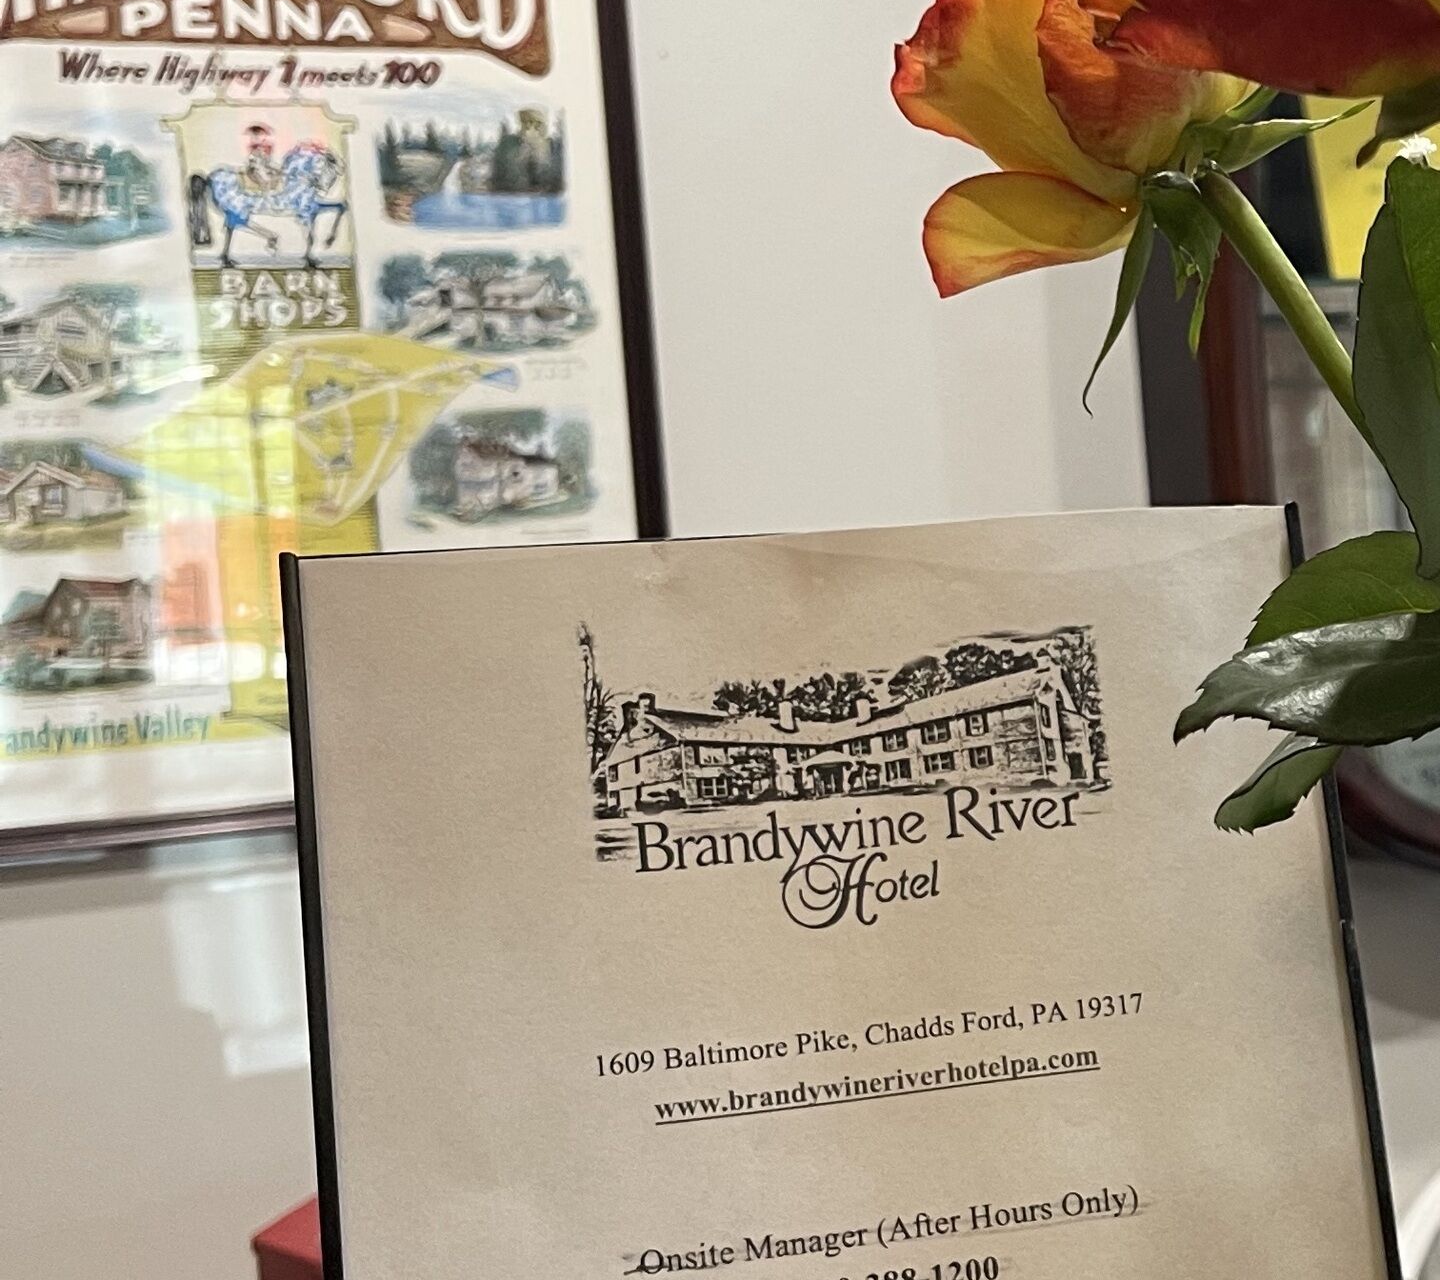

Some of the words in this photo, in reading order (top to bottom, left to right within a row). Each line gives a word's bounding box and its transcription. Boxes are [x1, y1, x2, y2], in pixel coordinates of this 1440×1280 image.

[59, 51, 147, 83] Where
[154, 54, 269, 92] Highway
[298, 65, 377, 86] meets
[382, 61, 440, 86] 100
[208, 298, 348, 329] SHOPS
[219, 270, 341, 299] BARN
[134, 704, 210, 742] Valley
[633, 806, 927, 884] Brandywine
[945, 786, 1081, 842] River
[782, 852, 939, 929] Hotel
[595, 1050, 654, 1077] 1609
[663, 1037, 788, 1071] Baltimore
[796, 1028, 857, 1056] Pike,
[865, 1016, 955, 1046] Chadds
[961, 1006, 1024, 1032] Ford,
[1030, 1002, 1067, 1025] PA
[1075, 992, 1143, 1022] 19317
[654, 1046, 1100, 1125] www.brandywineriverhotelpa.com
[638, 1244, 735, 1276] Onsite
[743, 1225, 869, 1265] Manager
[876, 1213, 961, 1248] (After
[968, 1200, 1054, 1230] Hours
[1061, 1183, 1139, 1218] Only)
